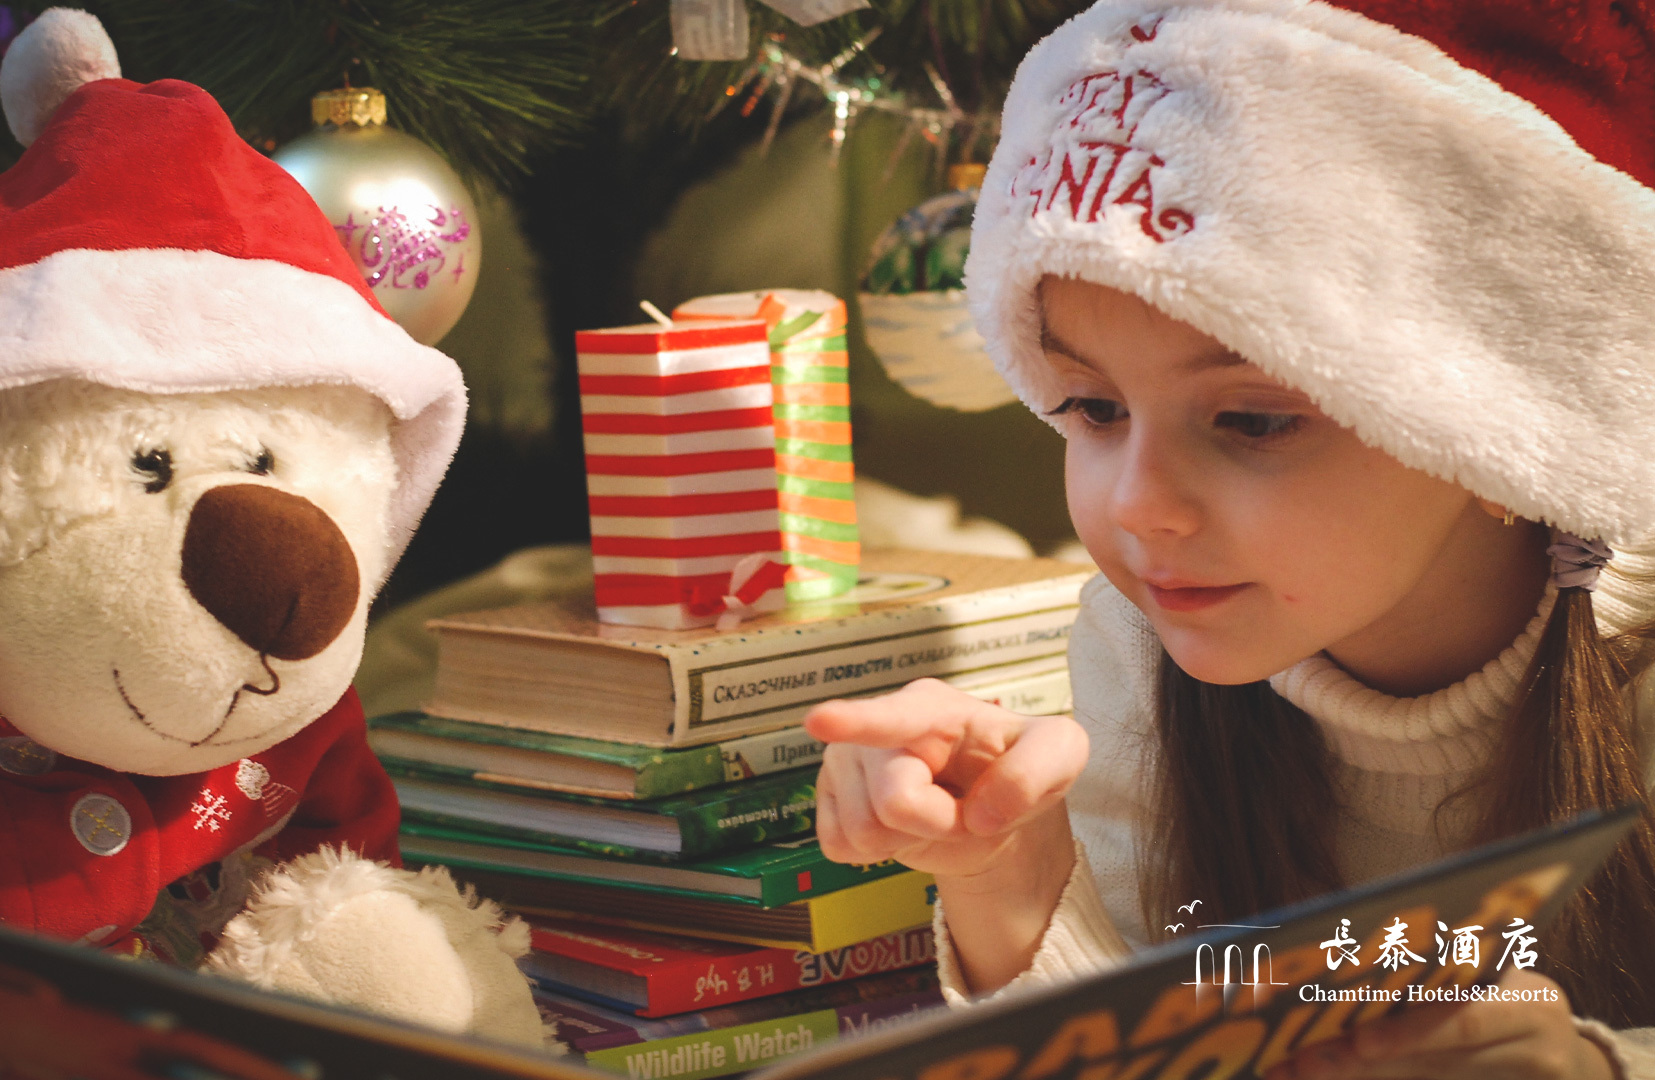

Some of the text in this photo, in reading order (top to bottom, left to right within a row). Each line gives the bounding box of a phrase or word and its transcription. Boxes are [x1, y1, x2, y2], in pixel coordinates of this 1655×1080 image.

[713, 671, 817, 704] СКАЗОЧНЫЕ
[822, 657, 893, 682] ПОВЕСТИ
[626, 1041, 726, 1080] Wildlife
[733, 1023, 814, 1063] Watch
